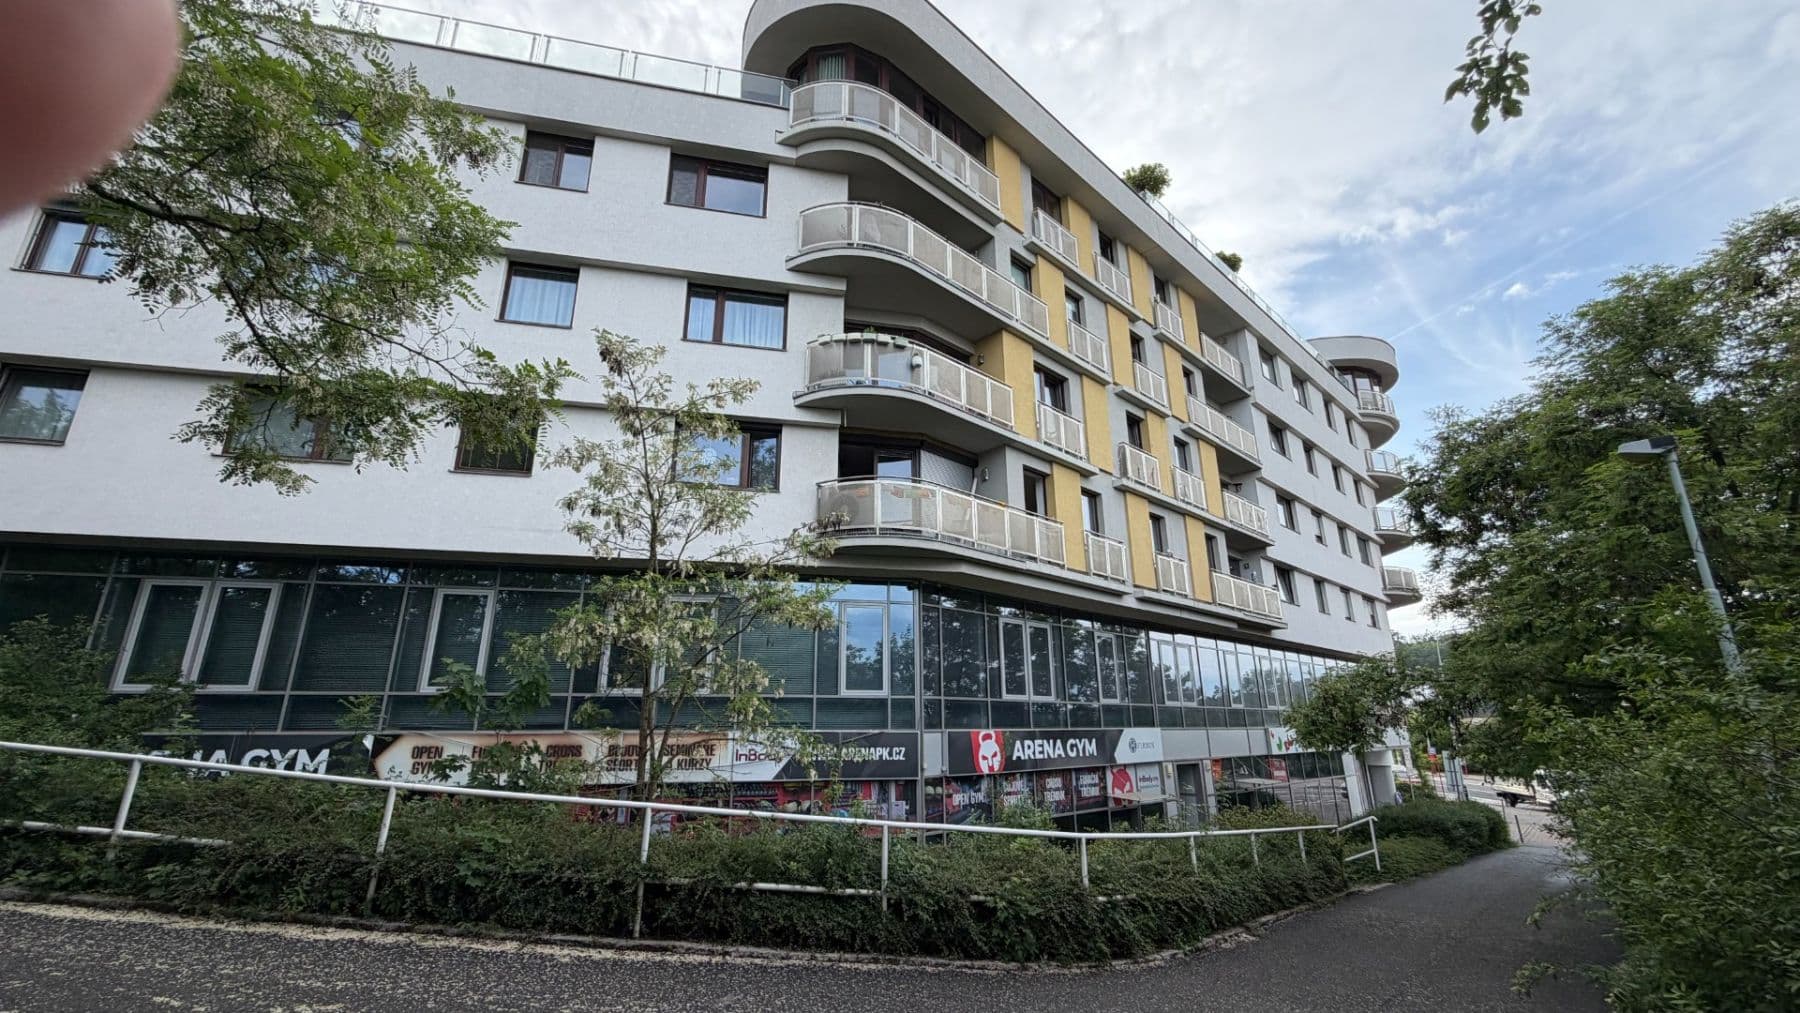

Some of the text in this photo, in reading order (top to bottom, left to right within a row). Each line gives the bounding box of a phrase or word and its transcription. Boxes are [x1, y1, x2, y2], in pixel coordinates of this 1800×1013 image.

[411, 745, 443, 759] OPEN
[545, 745, 582, 757] CROSS
[1012, 738, 1097, 761] ARENA GYM
[606, 758, 640, 772] SPORT
[677, 757, 712, 771] KURZY
